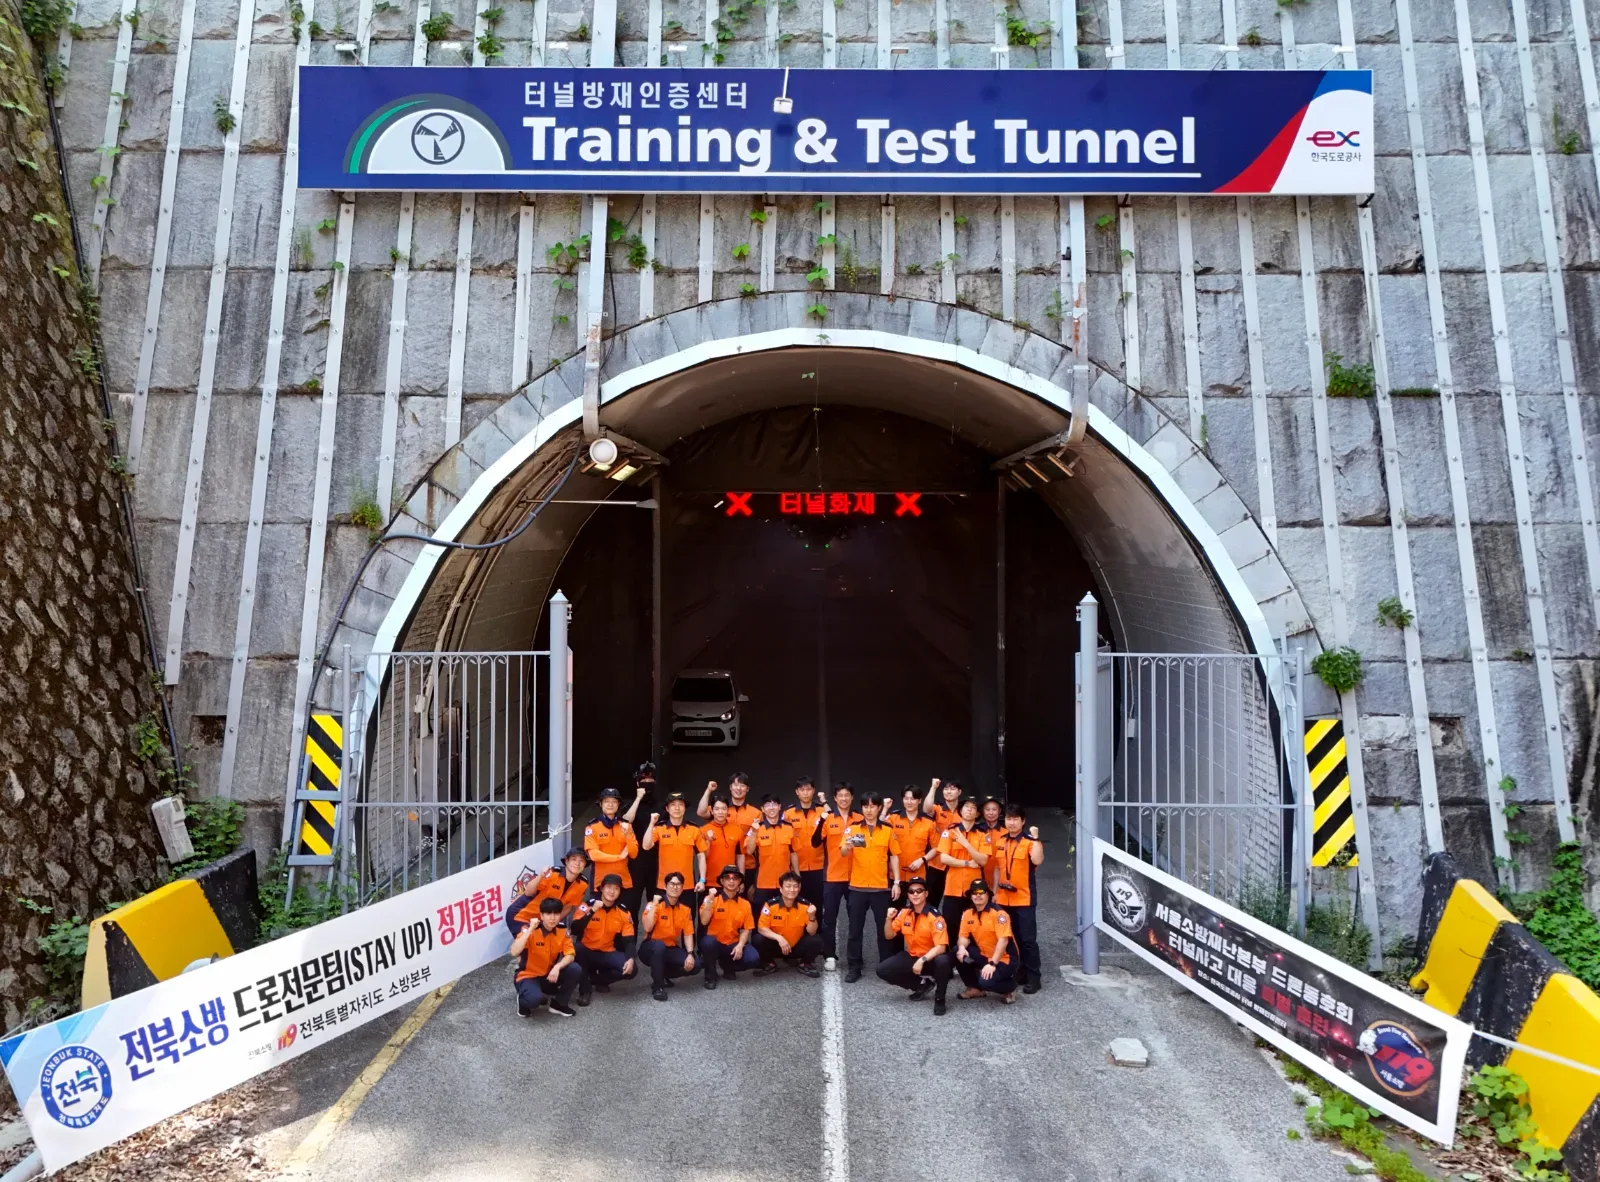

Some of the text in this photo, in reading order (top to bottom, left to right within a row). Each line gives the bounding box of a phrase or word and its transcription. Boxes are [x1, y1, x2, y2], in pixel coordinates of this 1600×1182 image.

[524, 81, 747, 109] 터널방재인증센터
[522, 115, 1195, 173] Training & Test Tunnel
[1306, 131, 1360, 147] ex
[1311, 152, 1361, 162] 한국도로공사
[780, 492, 875, 514] 터널화재
[1116, 888, 1133, 900] 119
[1155, 903, 1267, 975] 서울소방재난본부
[119, 884, 503, 1081] 전북소방 드론전문팀(STAY UP) 정기훈련
[1168, 931, 1223, 976] 터널사고
[1227, 964, 1257, 995] 대응
[299, 988, 384, 1039] 전북특별자치도
[388, 965, 432, 998] 소방본부
[42, 1048, 105, 1089] JEONBUK STATE
[55, 1065, 99, 1108] 전북
[1374, 1043, 1435, 1087] 119
